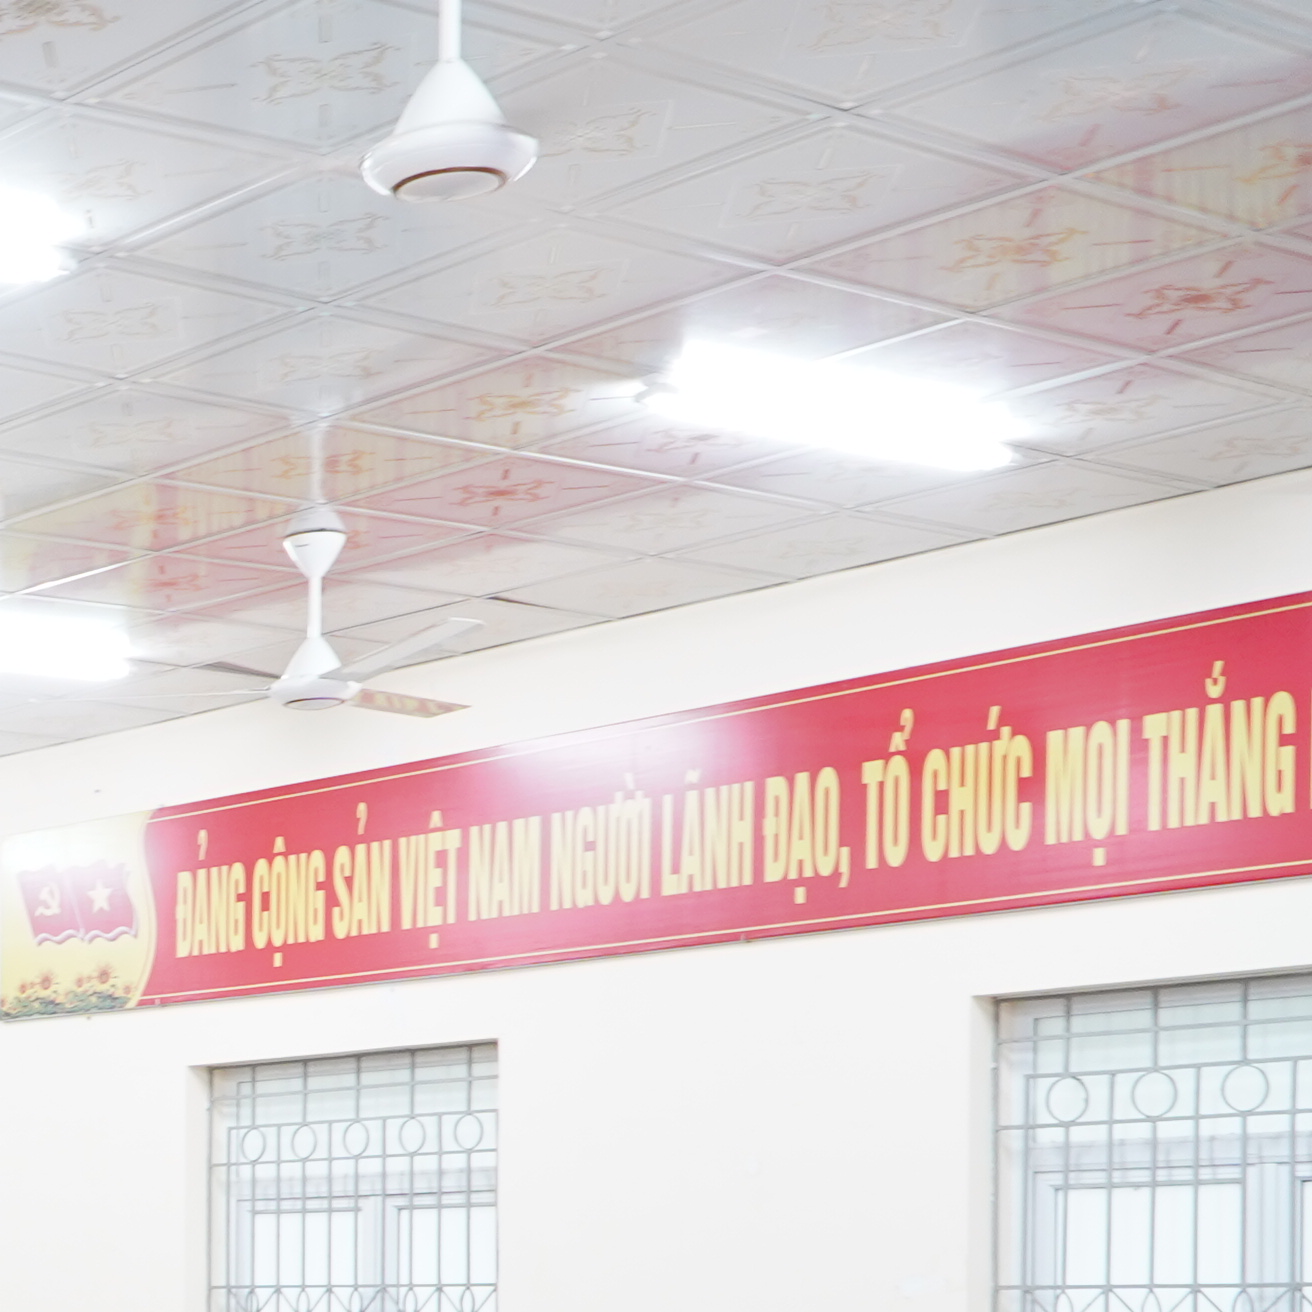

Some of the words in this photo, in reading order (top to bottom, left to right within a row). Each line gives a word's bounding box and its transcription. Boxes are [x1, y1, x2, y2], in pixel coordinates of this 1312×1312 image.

[175, 828, 246, 958] ĐẢNG
[252, 836, 326, 967] CỘNG
[332, 802, 392, 940] SẢN
[398, 810, 462, 949] VIỆT
[468, 815, 542, 921] NAM
[549, 771, 652, 911] NGƯỜI
[661, 769, 755, 896] LÃNH
[763, 766, 851, 905] ĐẠO,
[861, 708, 914, 869] TỔ
[921, 705, 1033, 862] CHỨC
[1044, 720, 1131, 867] MỌI
[1142, 660, 1297, 831] THẮNG
